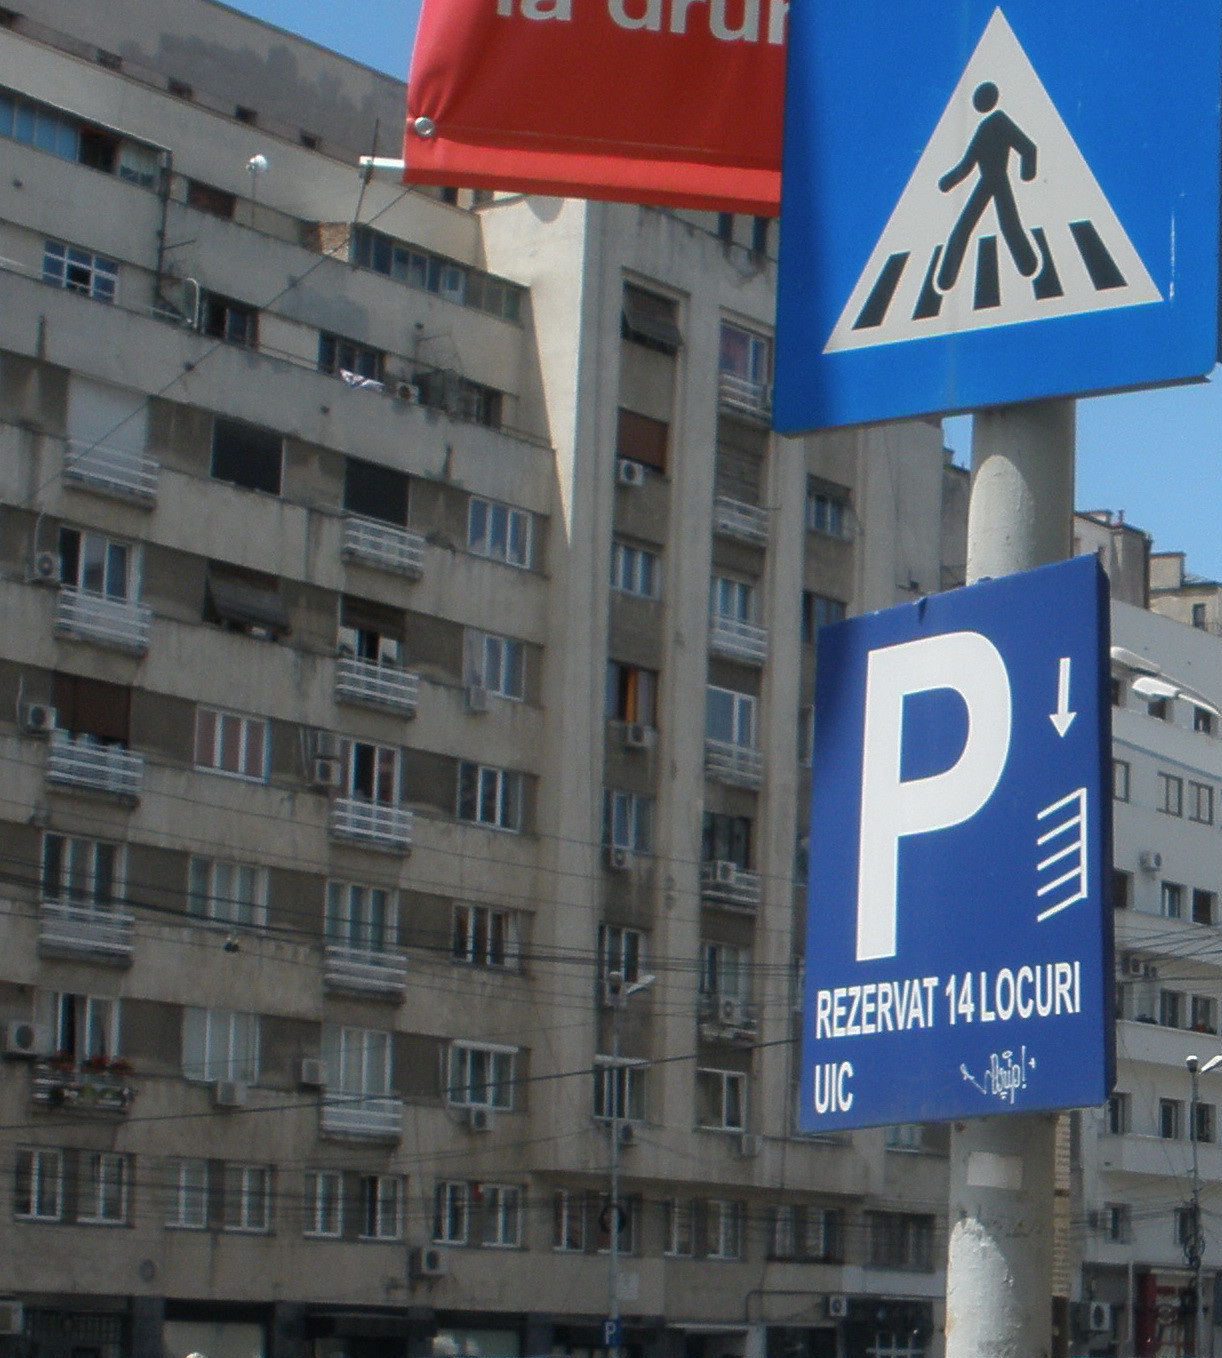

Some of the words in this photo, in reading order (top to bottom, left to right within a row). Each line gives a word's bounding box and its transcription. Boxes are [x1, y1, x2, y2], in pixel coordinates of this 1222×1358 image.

[855, 630, 1012, 962] P
[814, 975, 940, 1041] REZERVAT
[944, 970, 976, 1026] 14
[979, 960, 1082, 1023] LOCURI
[813, 1060, 855, 1114] UIC
[605, 1321, 617, 1345] P
